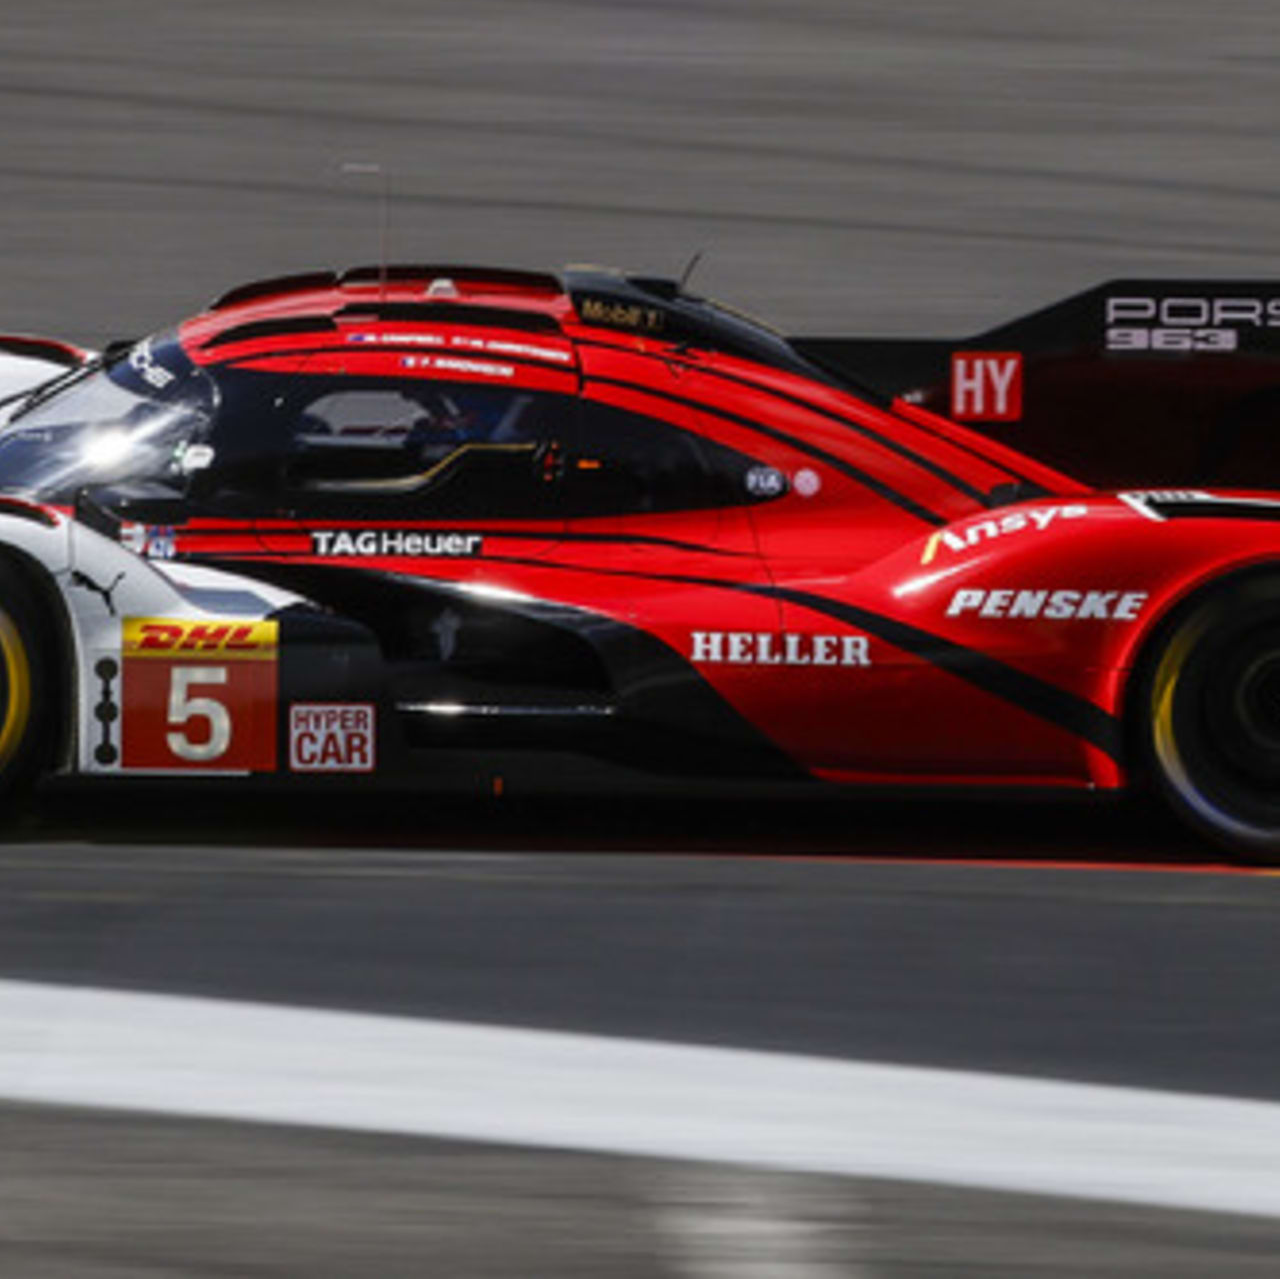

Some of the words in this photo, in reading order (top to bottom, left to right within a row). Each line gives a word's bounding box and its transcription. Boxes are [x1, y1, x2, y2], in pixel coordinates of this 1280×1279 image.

[581, 299, 640, 327] Mobil
[1105, 327, 1238, 351] 963
[953, 359, 1018, 415] HY
[311, 531, 377, 555] TAG
[381, 531, 483, 555] Heuer
[920, 502, 1088, 564] Ansys
[946, 589, 1148, 621] PENSKE
[136, 624, 260, 650] DHL
[691, 631, 872, 666] HELLER
[166, 666, 232, 762] 5
[294, 710, 369, 731] HYPER
[295, 732, 369, 765] CAR
